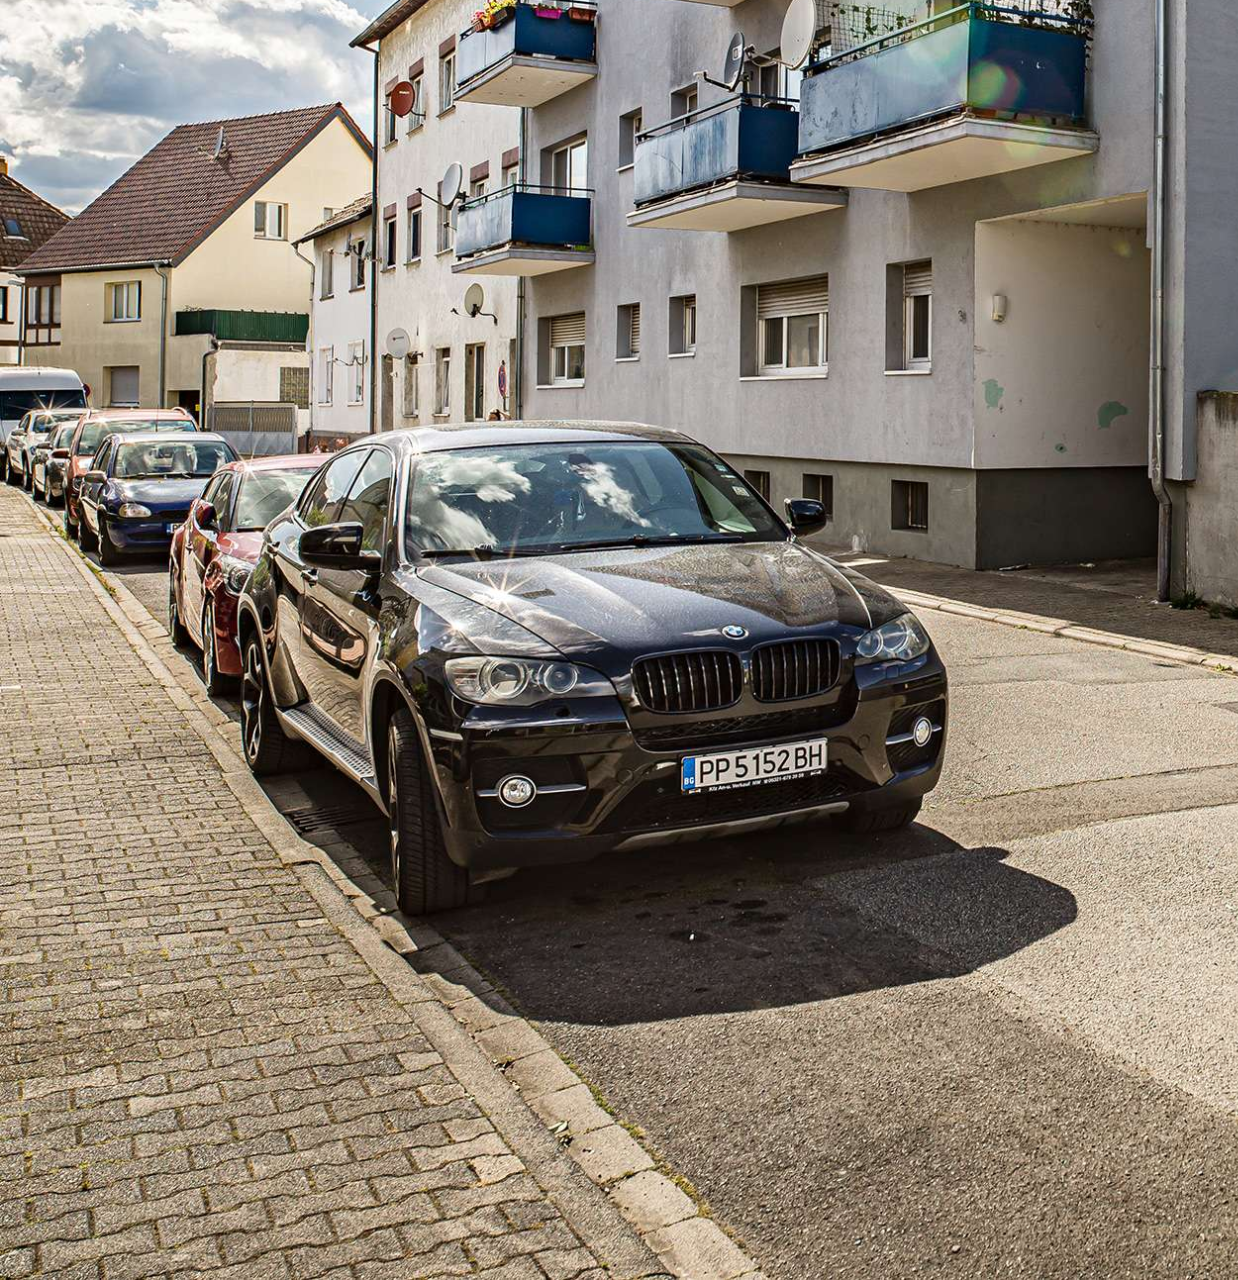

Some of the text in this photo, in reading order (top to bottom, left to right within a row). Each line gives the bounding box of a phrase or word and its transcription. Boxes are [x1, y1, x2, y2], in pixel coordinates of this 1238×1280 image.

[700, 743, 823, 783] PP 5152 BH
[684, 776, 695, 785] BG
